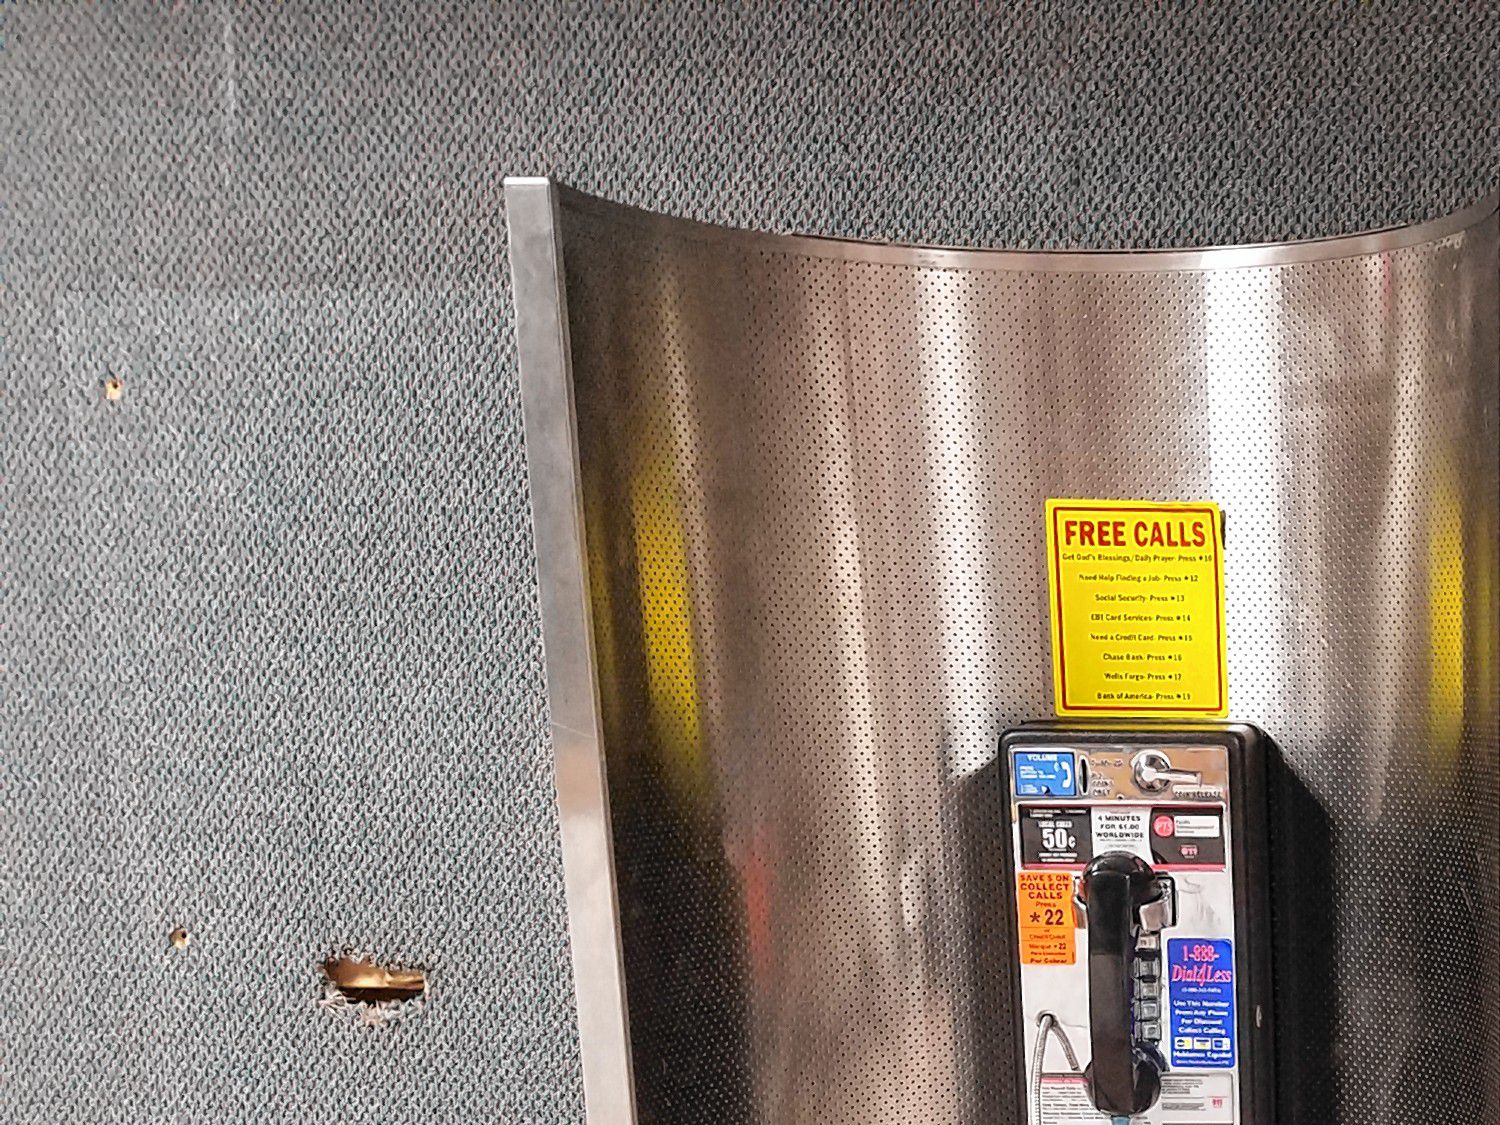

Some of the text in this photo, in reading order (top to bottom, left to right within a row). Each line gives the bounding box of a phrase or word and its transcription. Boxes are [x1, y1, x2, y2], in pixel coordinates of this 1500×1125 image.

[1065, 521, 1205, 547] FREE CALLS
[1099, 574, 1114, 582] Help
[1117, 574, 1141, 582] Finding
[1104, 672, 1123, 680] Wells
[1042, 828, 1076, 849] 50¢
[1020, 883, 1069, 891] COLLECT
[1203, 1027, 1226, 1035] Calling
